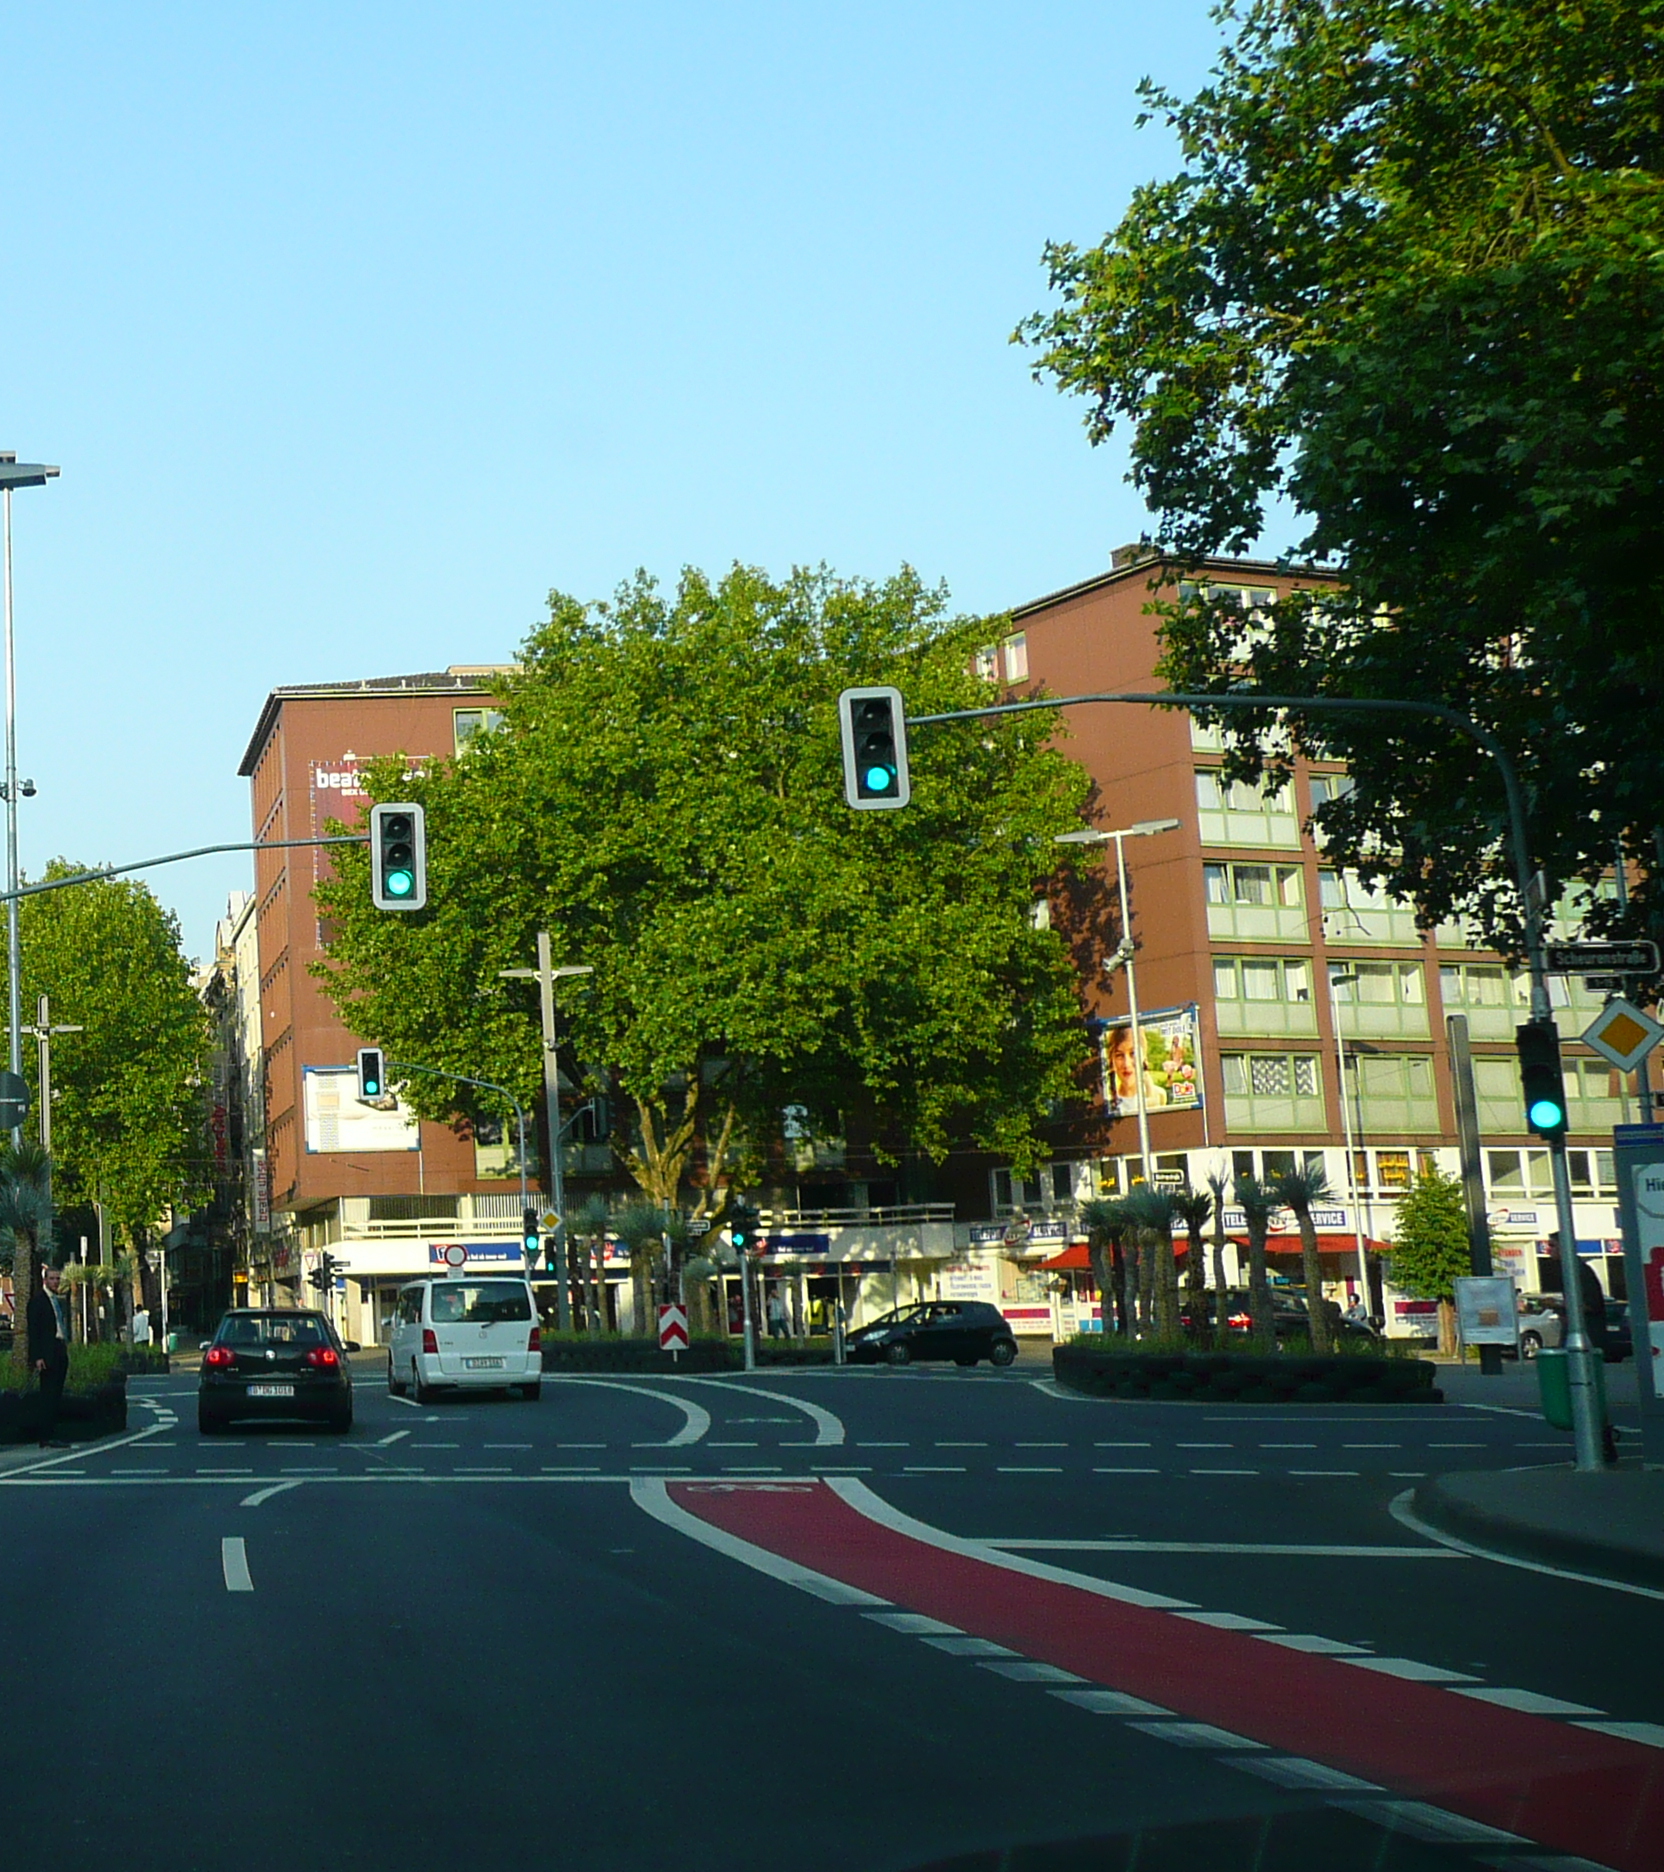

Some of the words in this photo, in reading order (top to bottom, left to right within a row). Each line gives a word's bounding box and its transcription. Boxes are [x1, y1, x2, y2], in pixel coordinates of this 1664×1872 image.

[315, 767, 372, 789] beat
[1554, 951, 1647, 965] Scheurenstraße
[256, 1160, 267, 1187] uhse
[257, 1190, 268, 1223] beate
[1224, 1212, 1248, 1226] TELE
[1309, 1212, 1343, 1226] ERVICE
